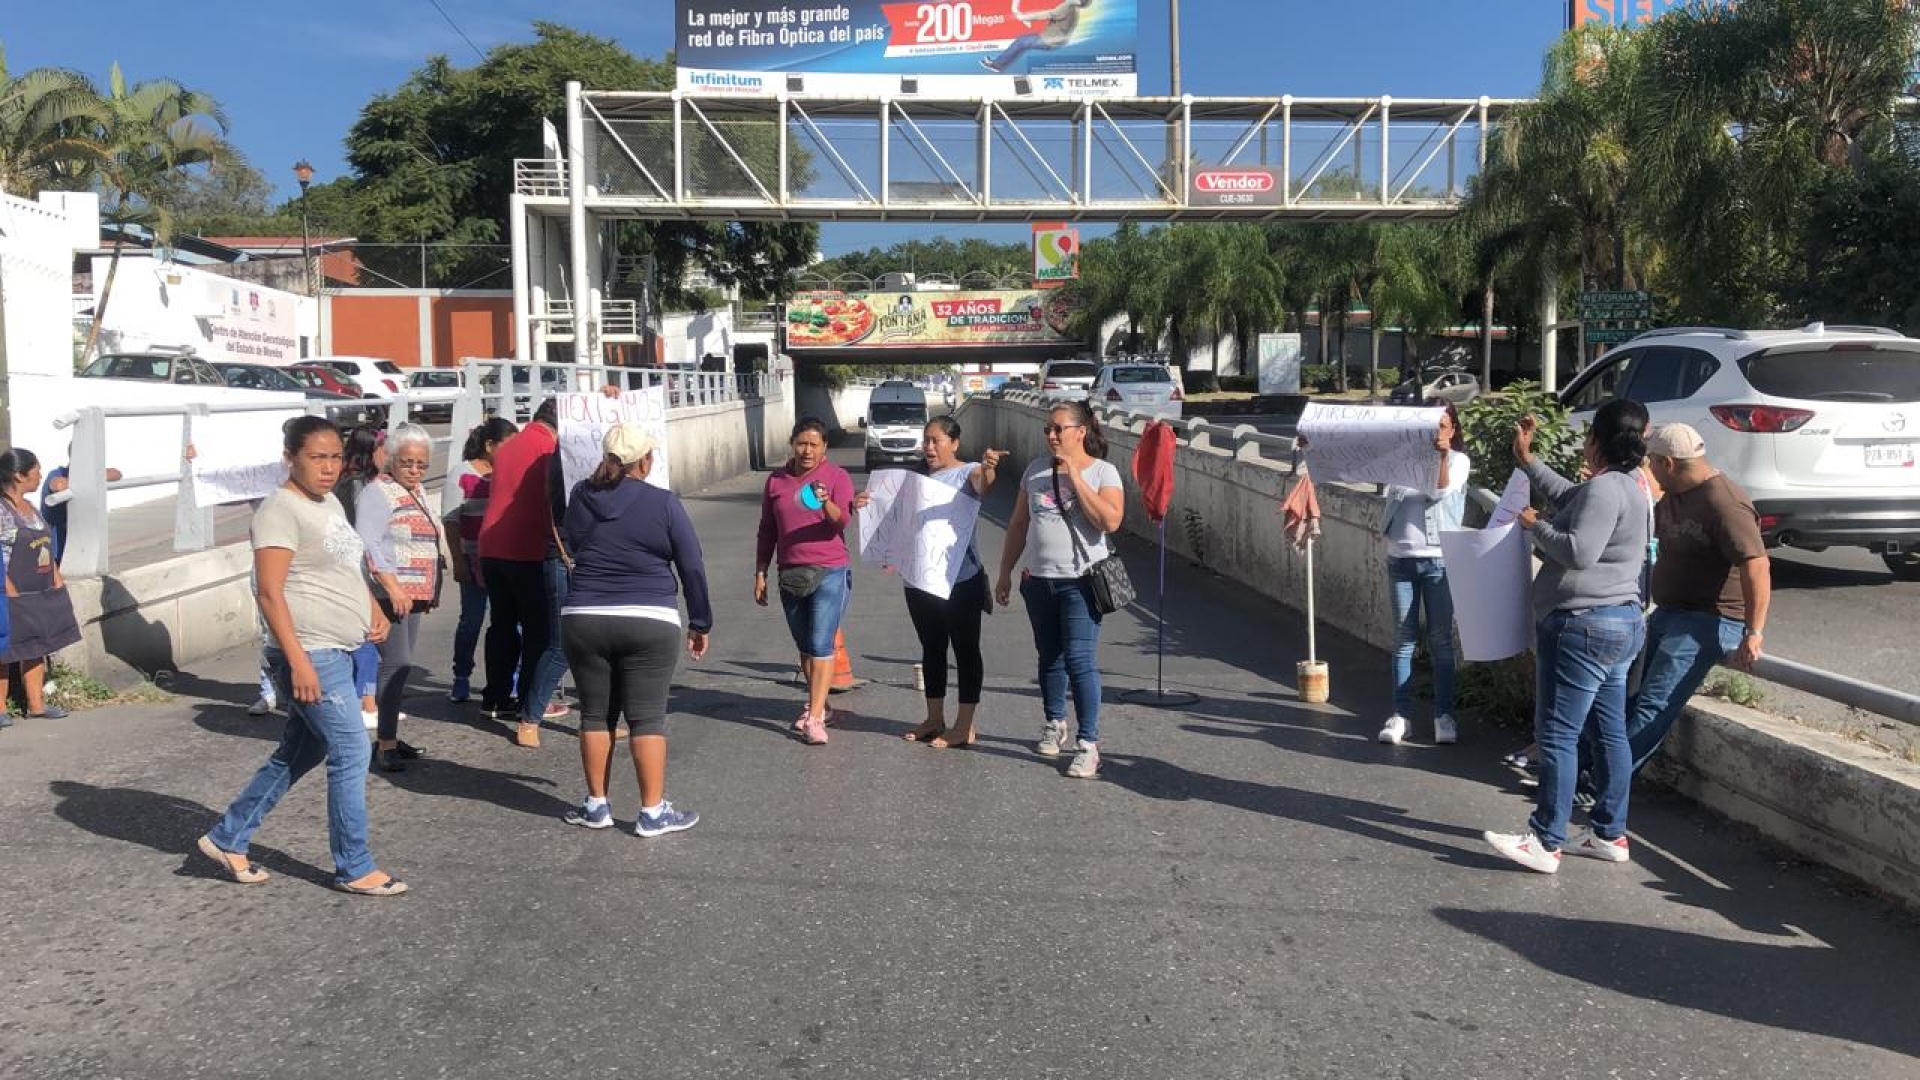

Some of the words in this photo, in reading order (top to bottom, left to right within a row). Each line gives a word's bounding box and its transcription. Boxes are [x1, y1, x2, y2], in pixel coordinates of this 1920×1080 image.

[688, 10, 706, 26] La
[709, 8, 750, 30] mejor
[754, 12, 763, 28] y
[767, 6, 796, 24] más
[800, 6, 850, 27] grande
[916, 2, 973, 43] 200
[972, 14, 1006, 28] Megas
[689, 31, 712, 47] red
[716, 29, 734, 46] de
[738, 27, 774, 46] Fibra
[779, 23, 824, 47] Óptica
[829, 25, 851, 43] del
[855, 24, 884, 44] país
[690, 71, 763, 87] infinitum
[1205, 174, 1265, 189] Vendor
[936, 304, 953, 316] 32
[956, 300, 996, 315] AÑOS
[950, 315, 965, 325] DE
